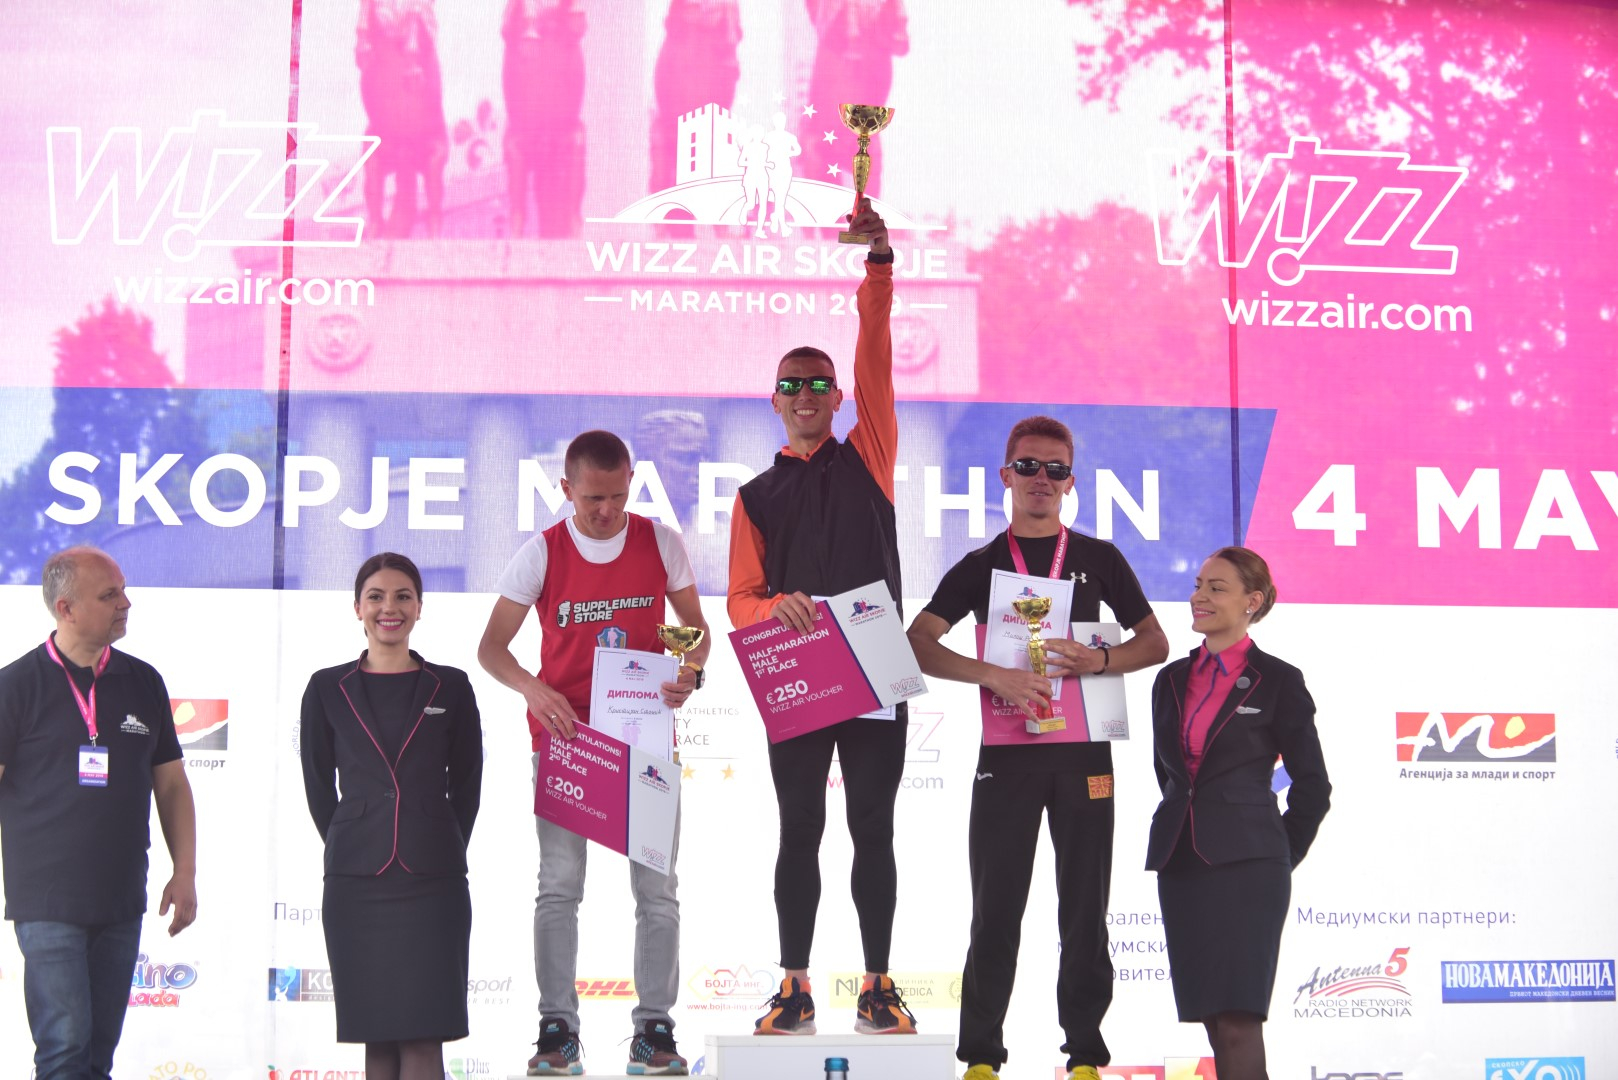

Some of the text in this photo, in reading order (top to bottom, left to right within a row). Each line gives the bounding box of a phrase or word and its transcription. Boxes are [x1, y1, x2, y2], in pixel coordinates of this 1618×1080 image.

[585, 241, 697, 273] WIZZ
[710, 243, 781, 275] AIR
[113, 268, 375, 306] wizzair.com
[631, 289, 902, 316] MARATHON 29
[1221, 291, 1472, 332] wizzair.com
[44, 450, 1160, 541] SKOPJE MARHN
[1291, 464, 1367, 546] 4
[573, 596, 655, 614] SUPPLEMENT
[574, 610, 614, 624] STORE
[742, 612, 824, 646] CONGRATUS!
[748, 628, 830, 662] HALF-MARATHON
[751, 655, 779, 670] MALE
[755, 658, 798, 679] 1ST PLACE
[606, 689, 660, 700] ДИПЛОМА
[770, 684, 844, 714] WIZZ AIR VOUCHER
[686, 707, 740, 715] ATHLETICS
[992, 708, 1012, 716] WIZZ
[575, 731, 622, 758] ATULATIONS!
[675, 734, 710, 745] RACE
[549, 745, 572, 761] MALE
[550, 736, 620, 774] HALF-MARATHON
[189, 759, 226, 771] спорт
[548, 752, 588, 777] 2ND PLACE
[1399, 768, 1556, 782] Агенција за млади и спорт
[545, 788, 607, 821] WIZZ AIR VOUCHER
[1297, 906, 1516, 929] Медиумски партнери:
[467, 976, 513, 994] sport
[1293, 947, 1411, 1005] Antenna 5
[575, 981, 635, 996] DHL
[1293, 1007, 1412, 1018] MACEDONIA
[1308, 999, 1412, 1007] RADIO NETWORK
